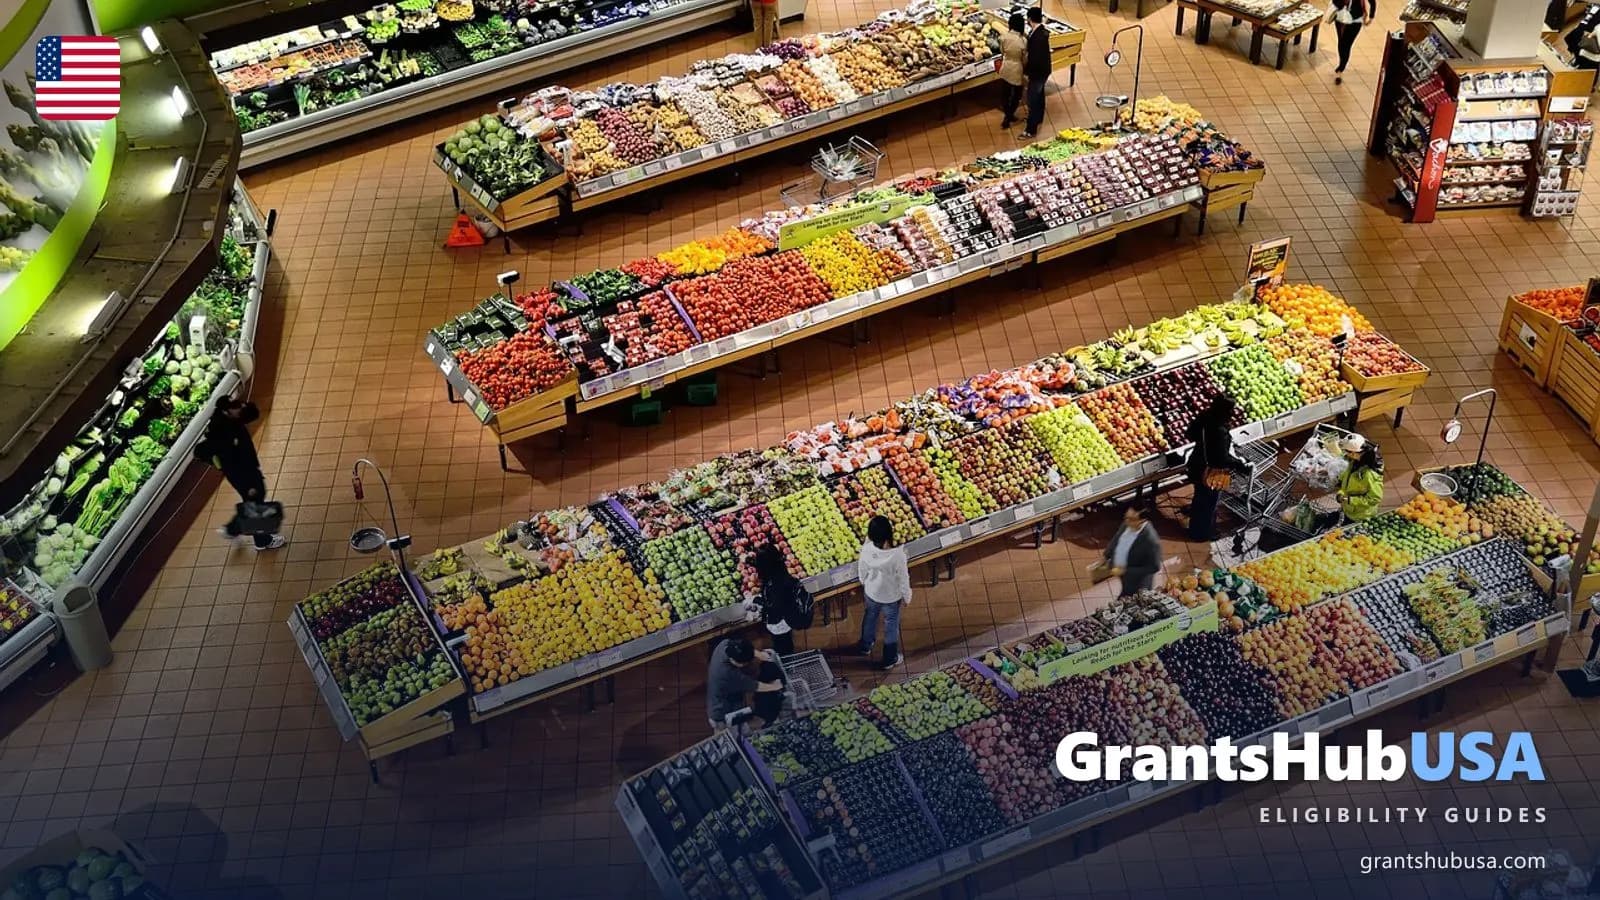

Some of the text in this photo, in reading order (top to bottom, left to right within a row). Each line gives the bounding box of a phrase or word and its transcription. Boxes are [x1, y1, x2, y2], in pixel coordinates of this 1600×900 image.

[1072, 651, 1099, 665] Looking
[1111, 635, 1144, 649] nutritious
[1145, 622, 1174, 637] choices?
[1090, 653, 1111, 664] Reach
[1112, 648, 1122, 656] for
[1123, 644, 1135, 652] the
